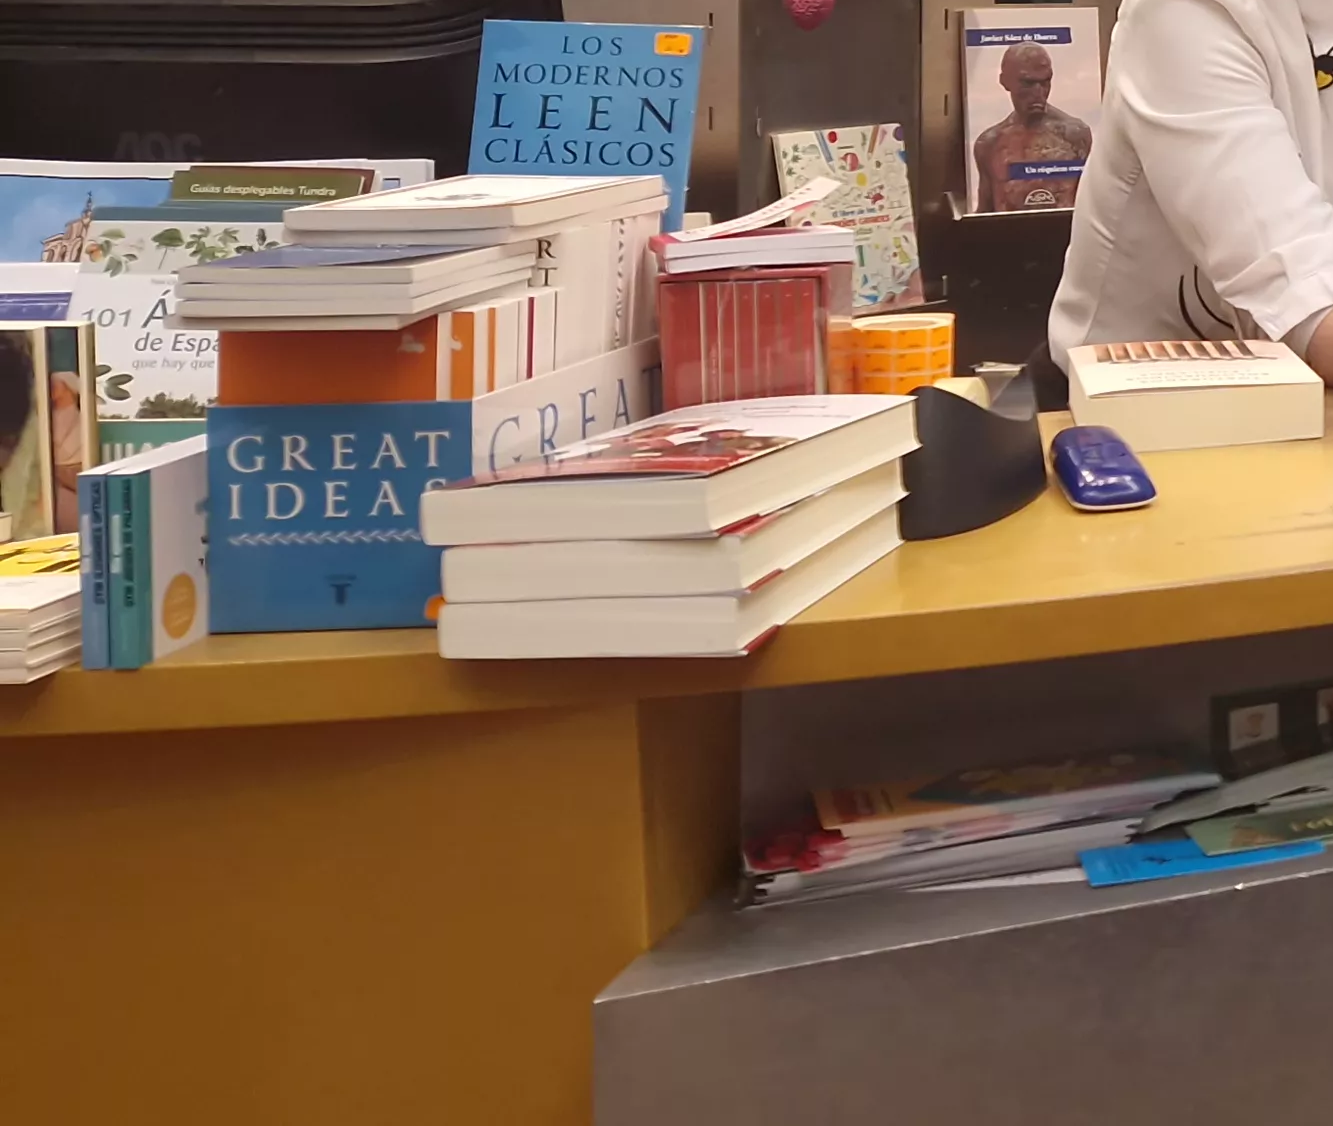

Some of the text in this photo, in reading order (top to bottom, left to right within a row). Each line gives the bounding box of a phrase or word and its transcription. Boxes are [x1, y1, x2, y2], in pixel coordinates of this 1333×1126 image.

[562, 36, 622, 56] LOS
[493, 63, 684, 88] MODERNOS
[489, 92, 679, 134] LEEN
[484, 134, 675, 167] CLÁSICOS
[190, 184, 336, 196] Guías desplegables Tundra
[82, 308, 132, 327] 101
[134, 333, 220, 357] de Espa
[132, 358, 215, 371] que hay que
[227, 431, 450, 474] GREAT
